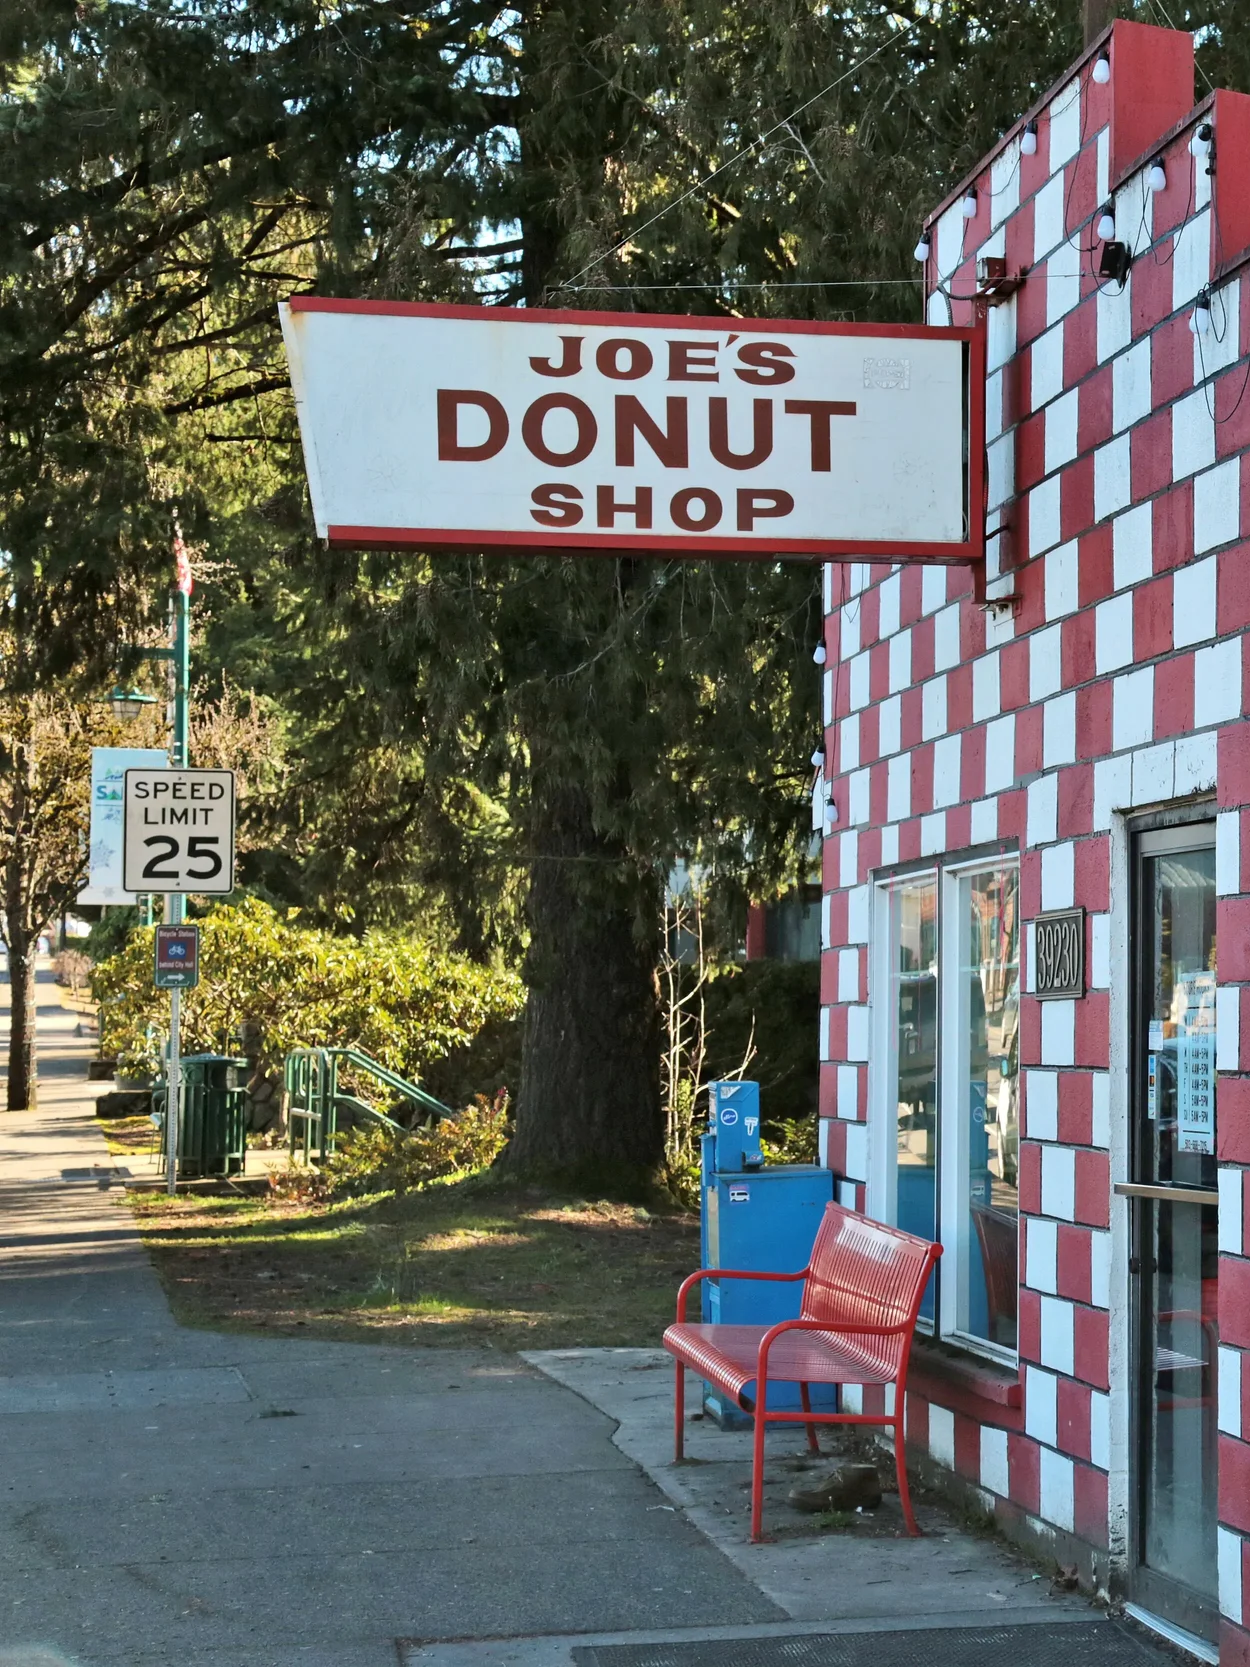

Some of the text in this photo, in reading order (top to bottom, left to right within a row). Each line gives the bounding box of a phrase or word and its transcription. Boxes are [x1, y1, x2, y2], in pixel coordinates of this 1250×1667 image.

[528, 334, 798, 386] JOE'S
[437, 389, 857, 472] DONUT
[529, 483, 795, 532] SHOP
[134, 781, 225, 800] SPEED
[144, 807, 214, 826] LIMIT
[142, 835, 223, 880] 25
[1037, 922, 1078, 989] 39230
